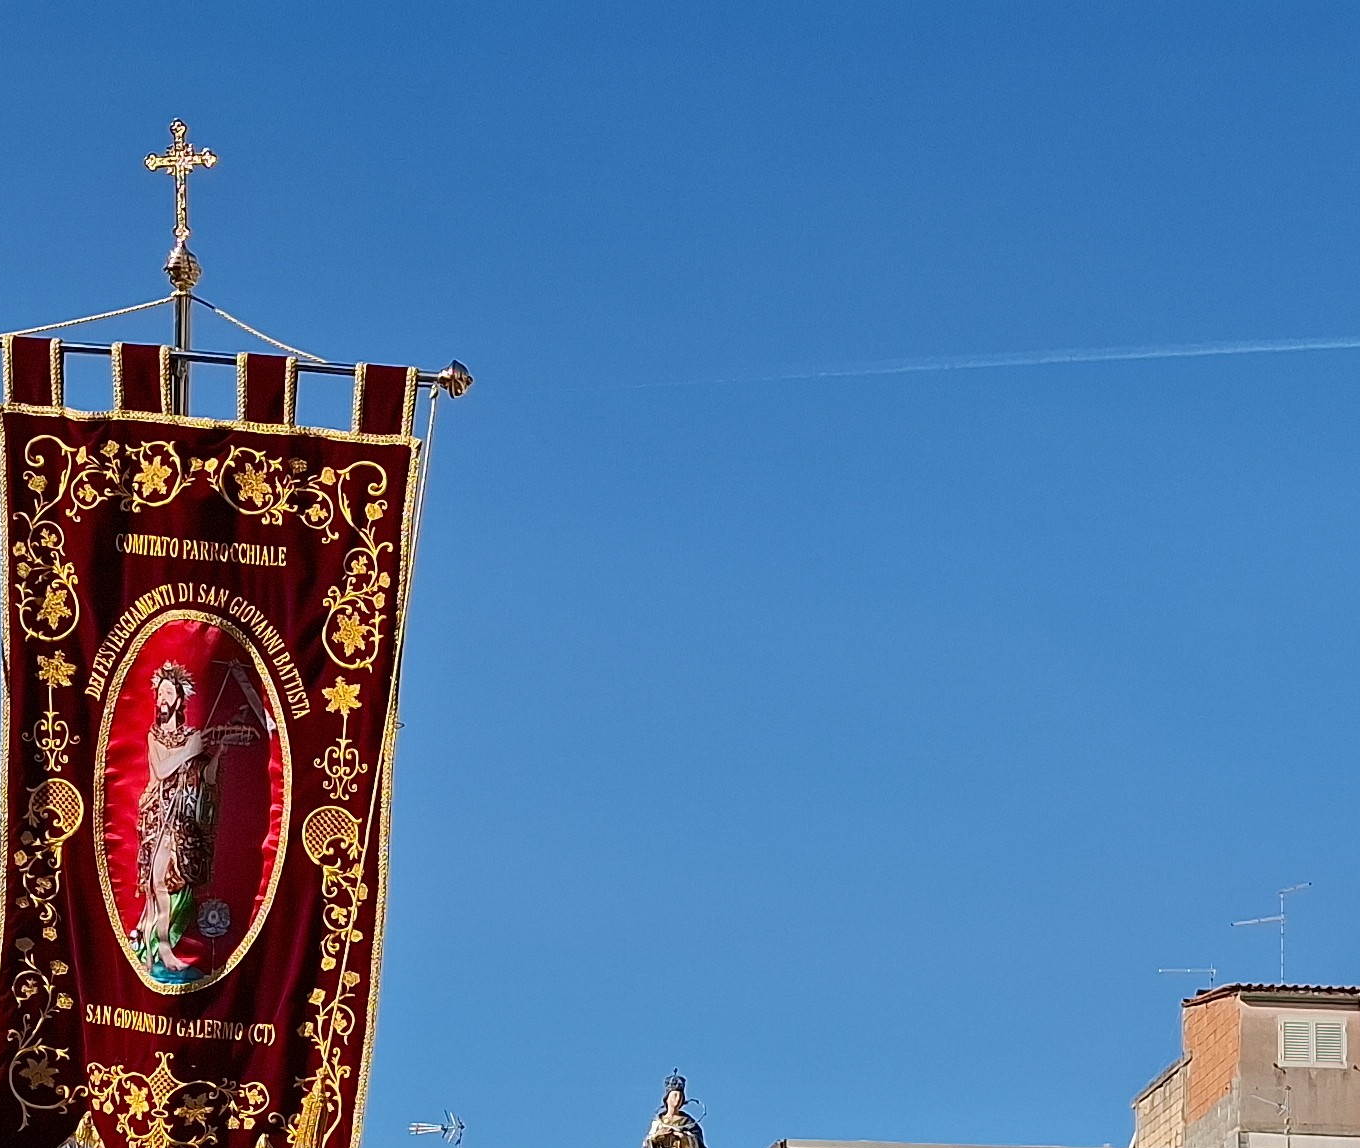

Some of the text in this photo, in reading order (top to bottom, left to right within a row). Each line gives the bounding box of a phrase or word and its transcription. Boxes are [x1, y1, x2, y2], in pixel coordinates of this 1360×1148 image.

[115, 533, 287, 567] COMITATO PARROCCHIALE
[84, 582, 311, 720] DEI FESTEGGIAMENTI DI SAN GIOVANNI BATTISTA
[85, 1003, 112, 1026] SAN
[157, 1015, 173, 1036] DI
[176, 1018, 243, 1041] GALERMO
[248, 1023, 276, 1047] (CT)
